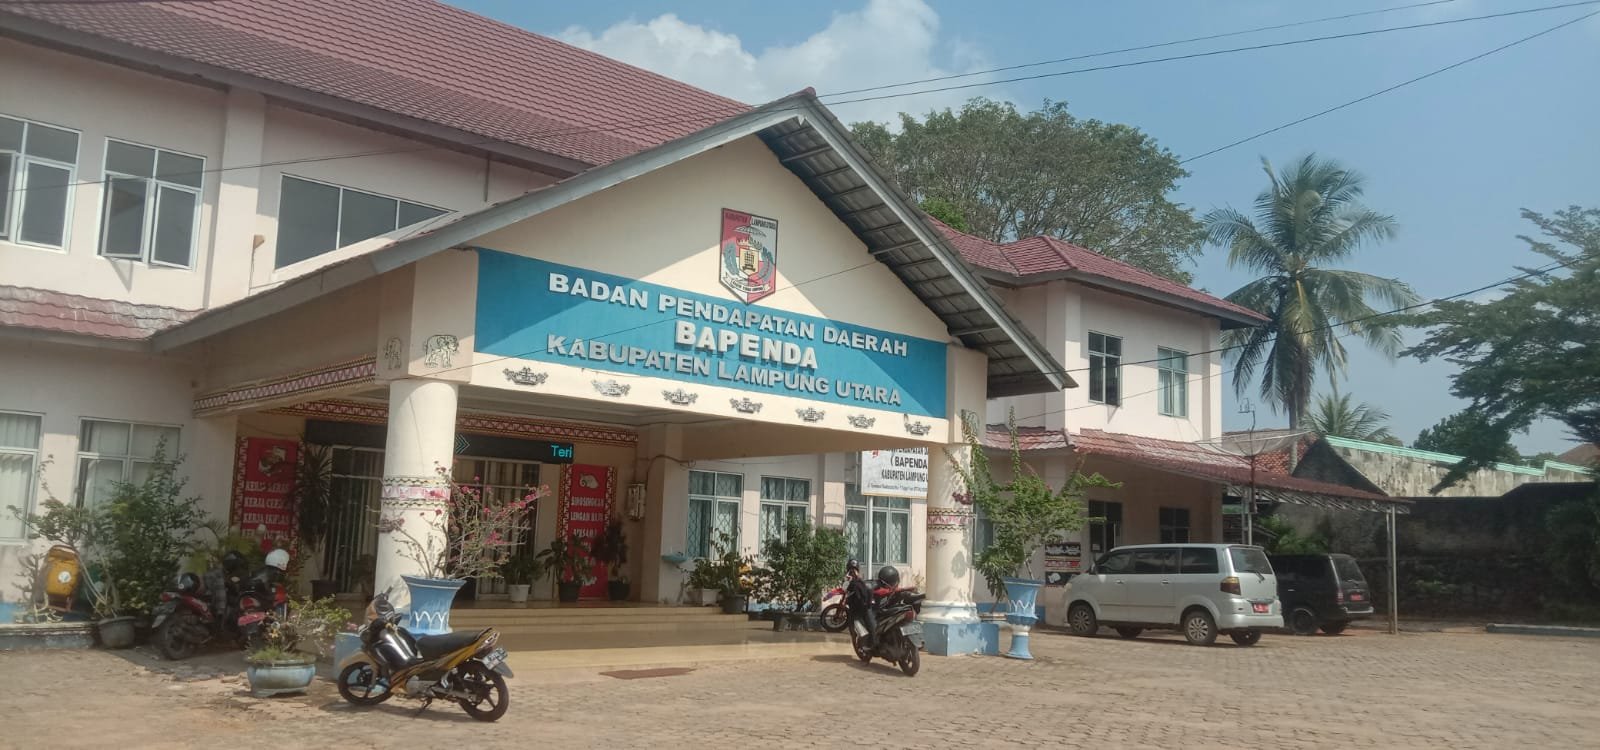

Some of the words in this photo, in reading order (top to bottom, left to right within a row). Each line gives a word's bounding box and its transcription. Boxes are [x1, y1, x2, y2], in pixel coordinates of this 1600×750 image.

[549, 272, 649, 308] BADAN
[658, 293, 815, 340] PENDAPATAN
[823, 326, 908, 357] DAERAH
[547, 333, 710, 376] KABUPATEN
[717, 361, 830, 394] LAMPUNG
[835, 379, 902, 407] UTARA
[675, 319, 818, 370] BAPENDA
[551, 445, 572, 458] Teri
[882, 469, 905, 481] KABUPATEN
[906, 471, 926, 482] LAMPUNG
